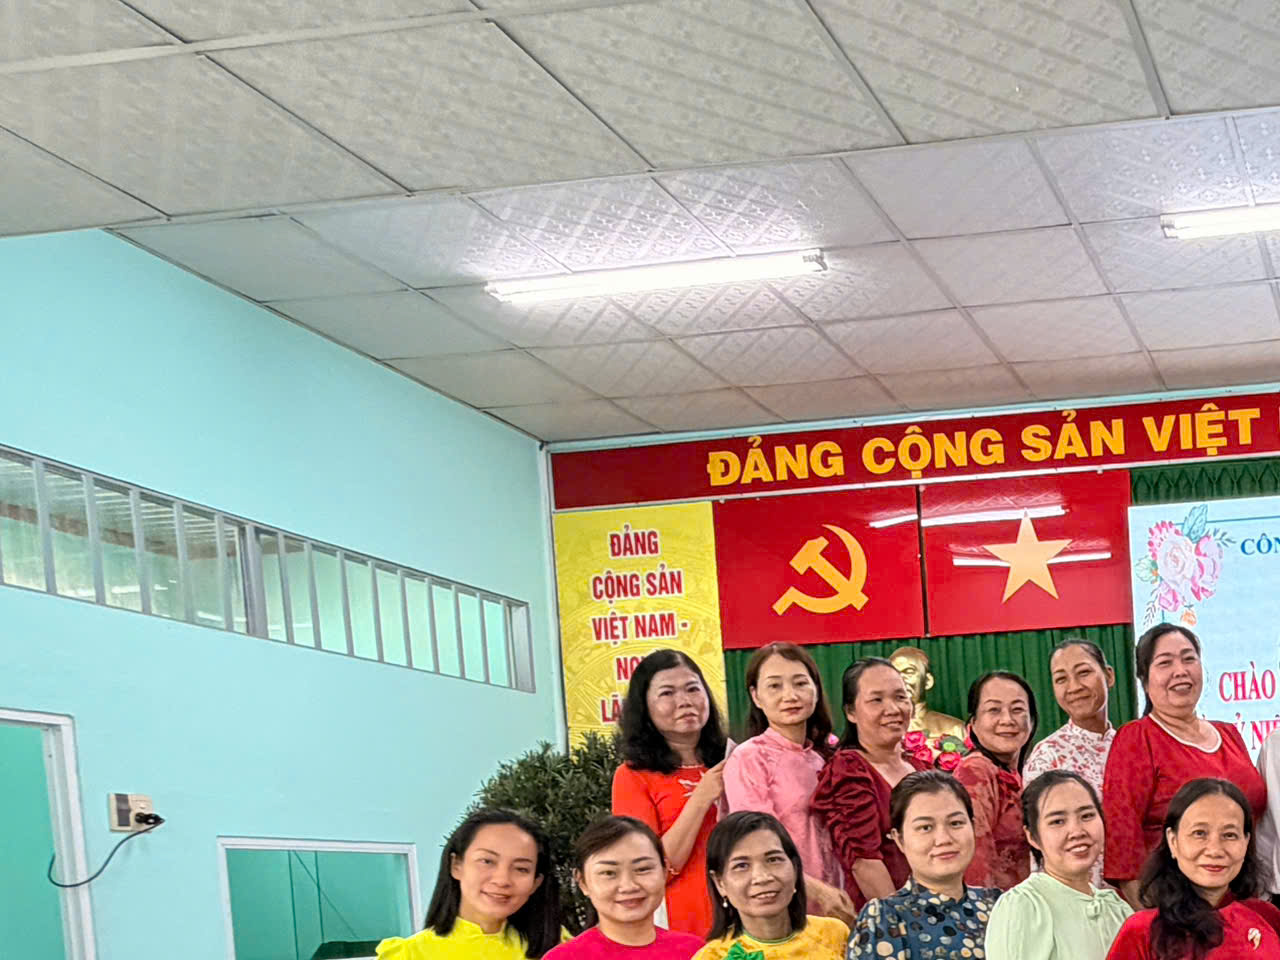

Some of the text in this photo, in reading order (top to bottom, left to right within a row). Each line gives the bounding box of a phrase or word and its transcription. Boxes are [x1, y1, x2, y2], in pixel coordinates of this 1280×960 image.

[707, 435, 845, 487] ĐẢNG
[861, 425, 1006, 479] CỘNG
[1021, 410, 1126, 462] SẢN
[1143, 403, 1261, 456] VIỆT
[610, 524, 659, 557] ĐẢNG
[592, 563, 683, 604] CỘNG SẢN
[592, 611, 629, 645] VIỆT
[635, 613, 676, 639] NAM
[1219, 661, 1277, 703] CHÀO
